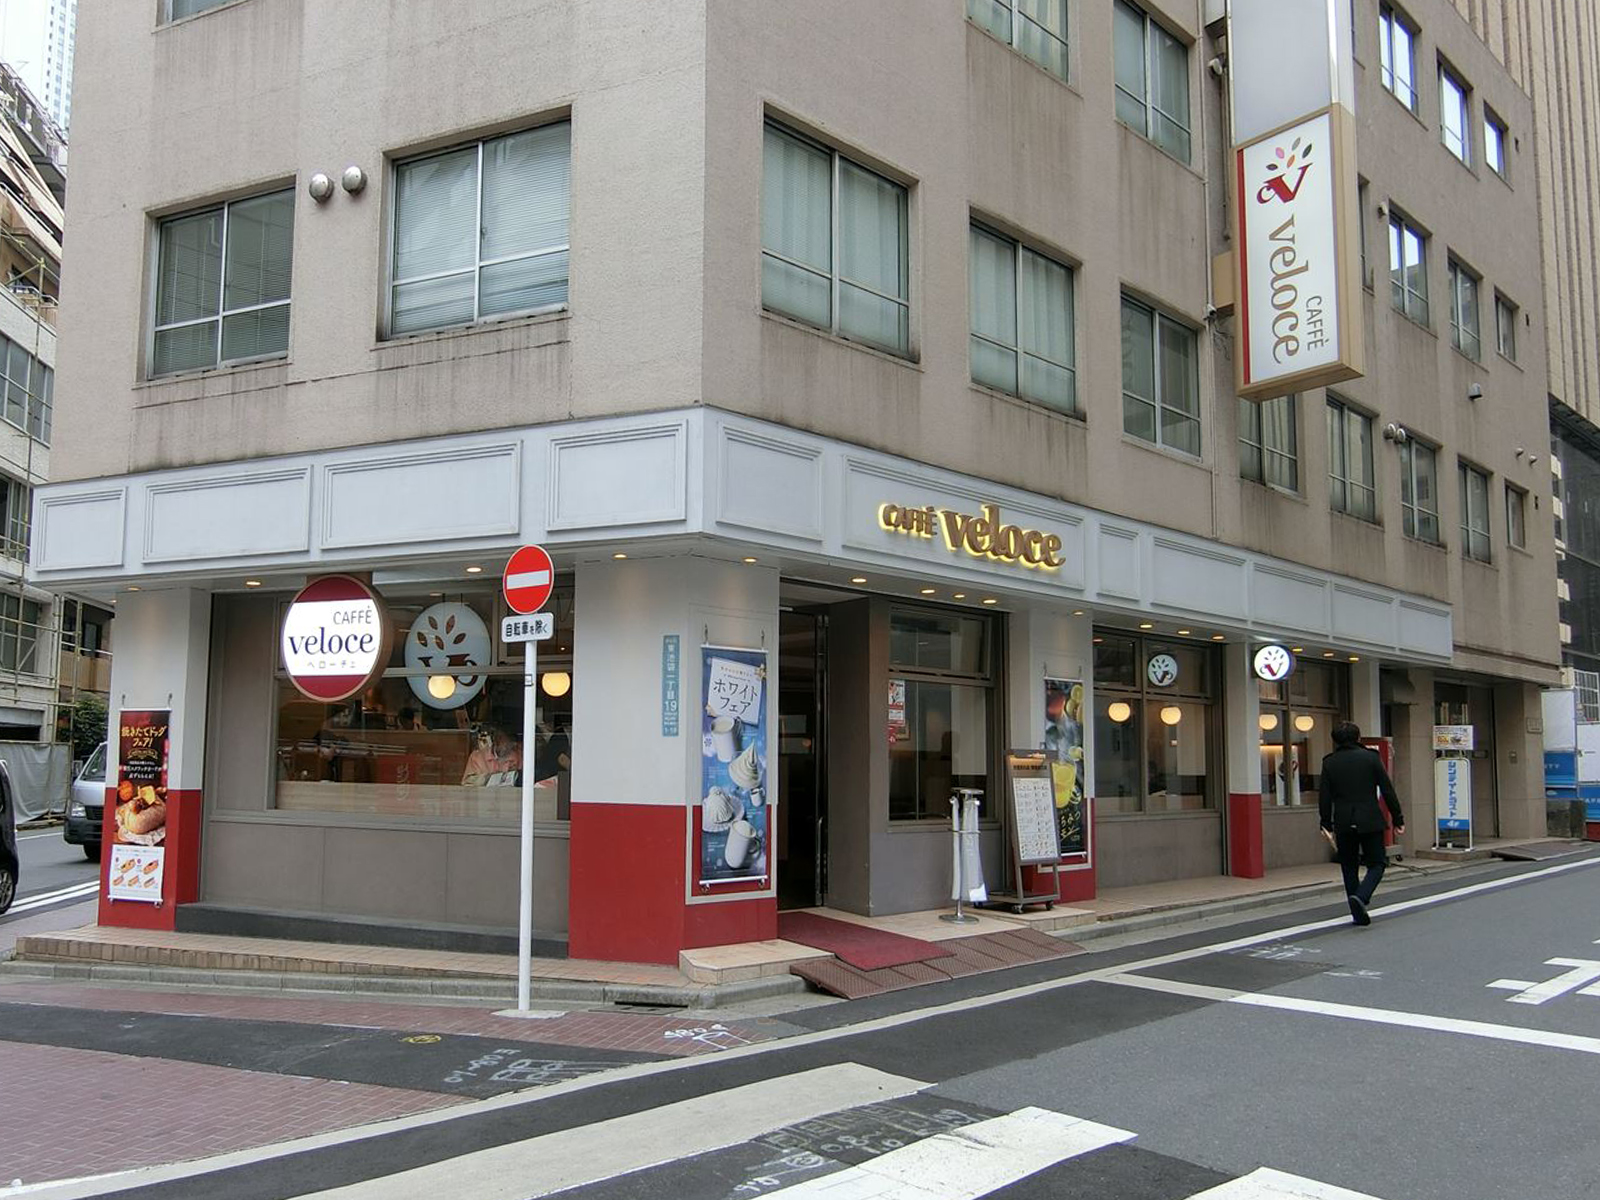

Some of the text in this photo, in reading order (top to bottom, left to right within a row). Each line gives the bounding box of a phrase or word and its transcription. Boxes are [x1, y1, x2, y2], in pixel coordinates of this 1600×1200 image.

[1268, 213, 1309, 364] veloce
[939, 502, 1066, 568] veloce
[505, 619, 549, 638] 自転車を除く
[287, 626, 377, 656] veloce
[713, 678, 758, 702] ホワイト
[664, 700, 678, 712] 19
[720, 696, 752, 715] フェア
